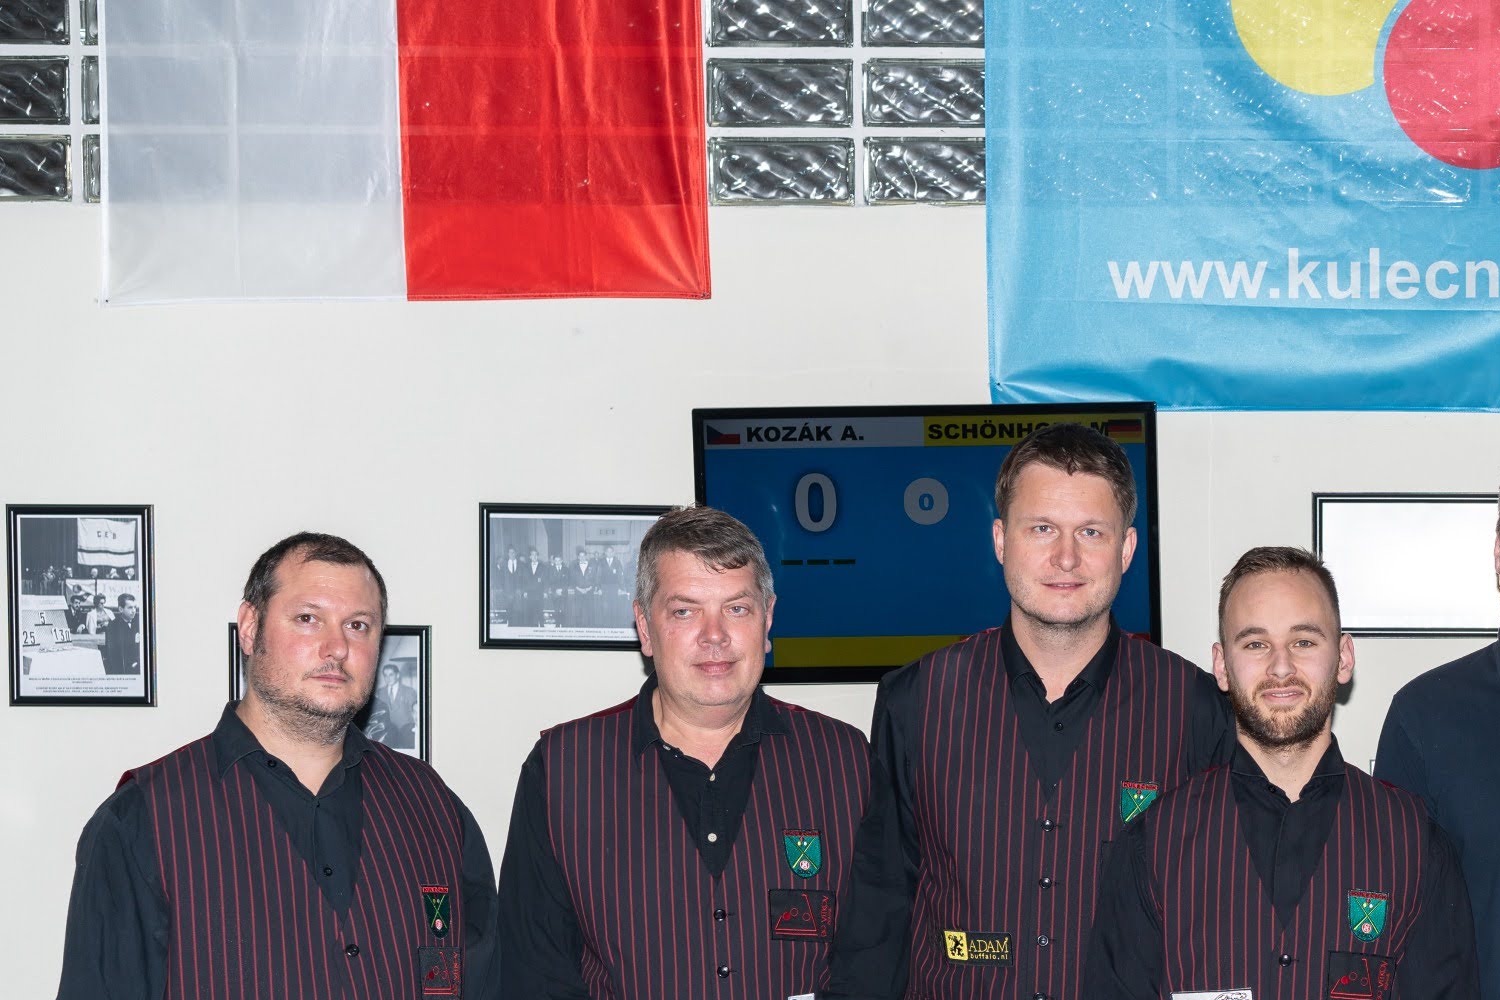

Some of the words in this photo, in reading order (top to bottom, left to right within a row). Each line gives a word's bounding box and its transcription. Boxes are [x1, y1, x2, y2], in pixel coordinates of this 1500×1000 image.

[746, 422, 833, 443] KOZÁK
[840, 425, 865, 441] A.
[794, 472, 838, 533] 0
[22, 630, 36, 644] 25
[969, 938, 1009, 953] ADAM
